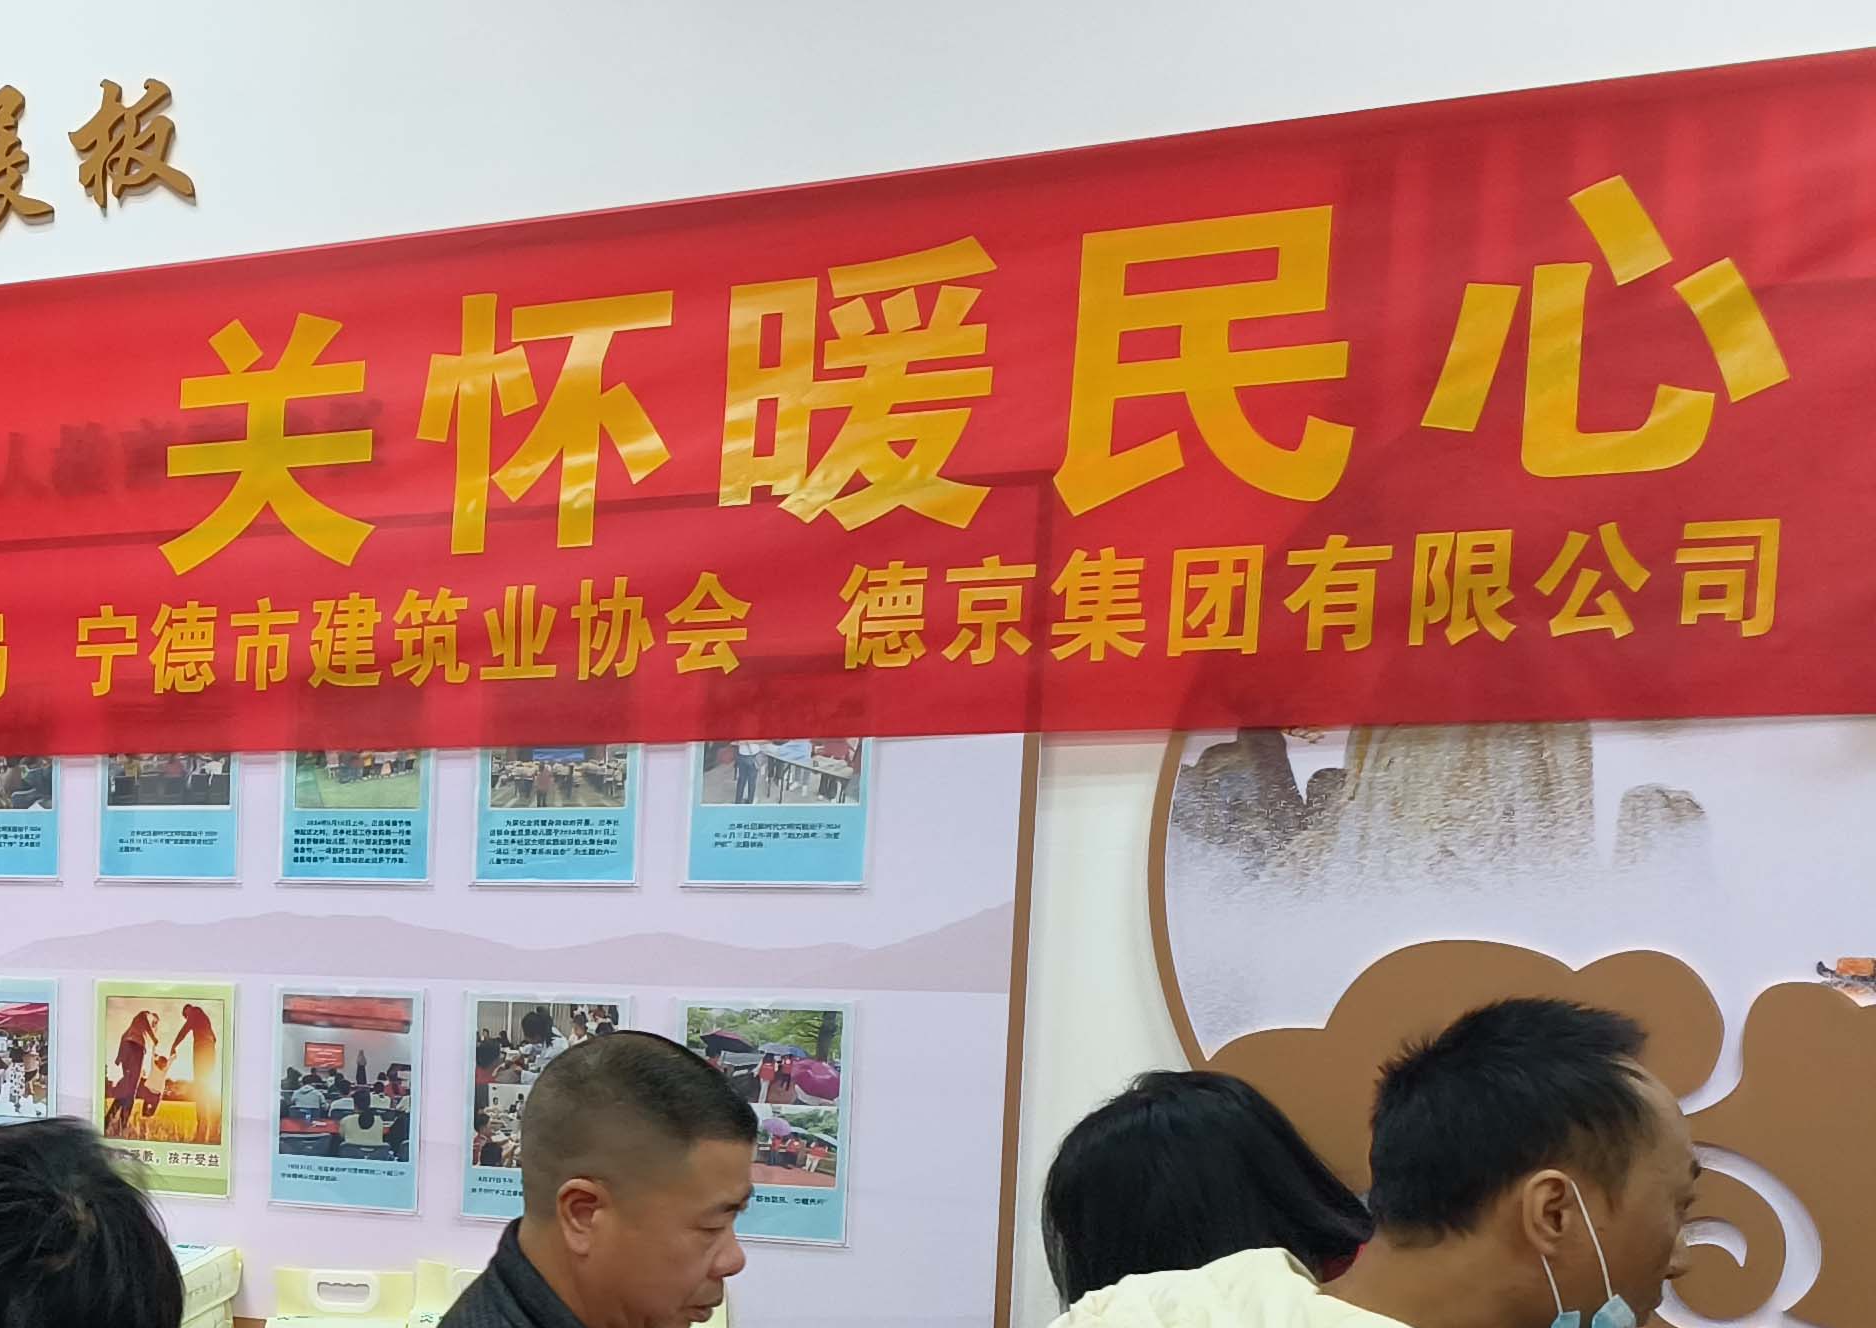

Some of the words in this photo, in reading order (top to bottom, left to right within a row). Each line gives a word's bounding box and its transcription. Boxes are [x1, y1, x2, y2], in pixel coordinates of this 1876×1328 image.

[162, 175, 1790, 578] 关怀暖民心
[77, 568, 752, 698] 宁德市建筑业协会
[837, 518, 1782, 670] 德京集团有限公司
